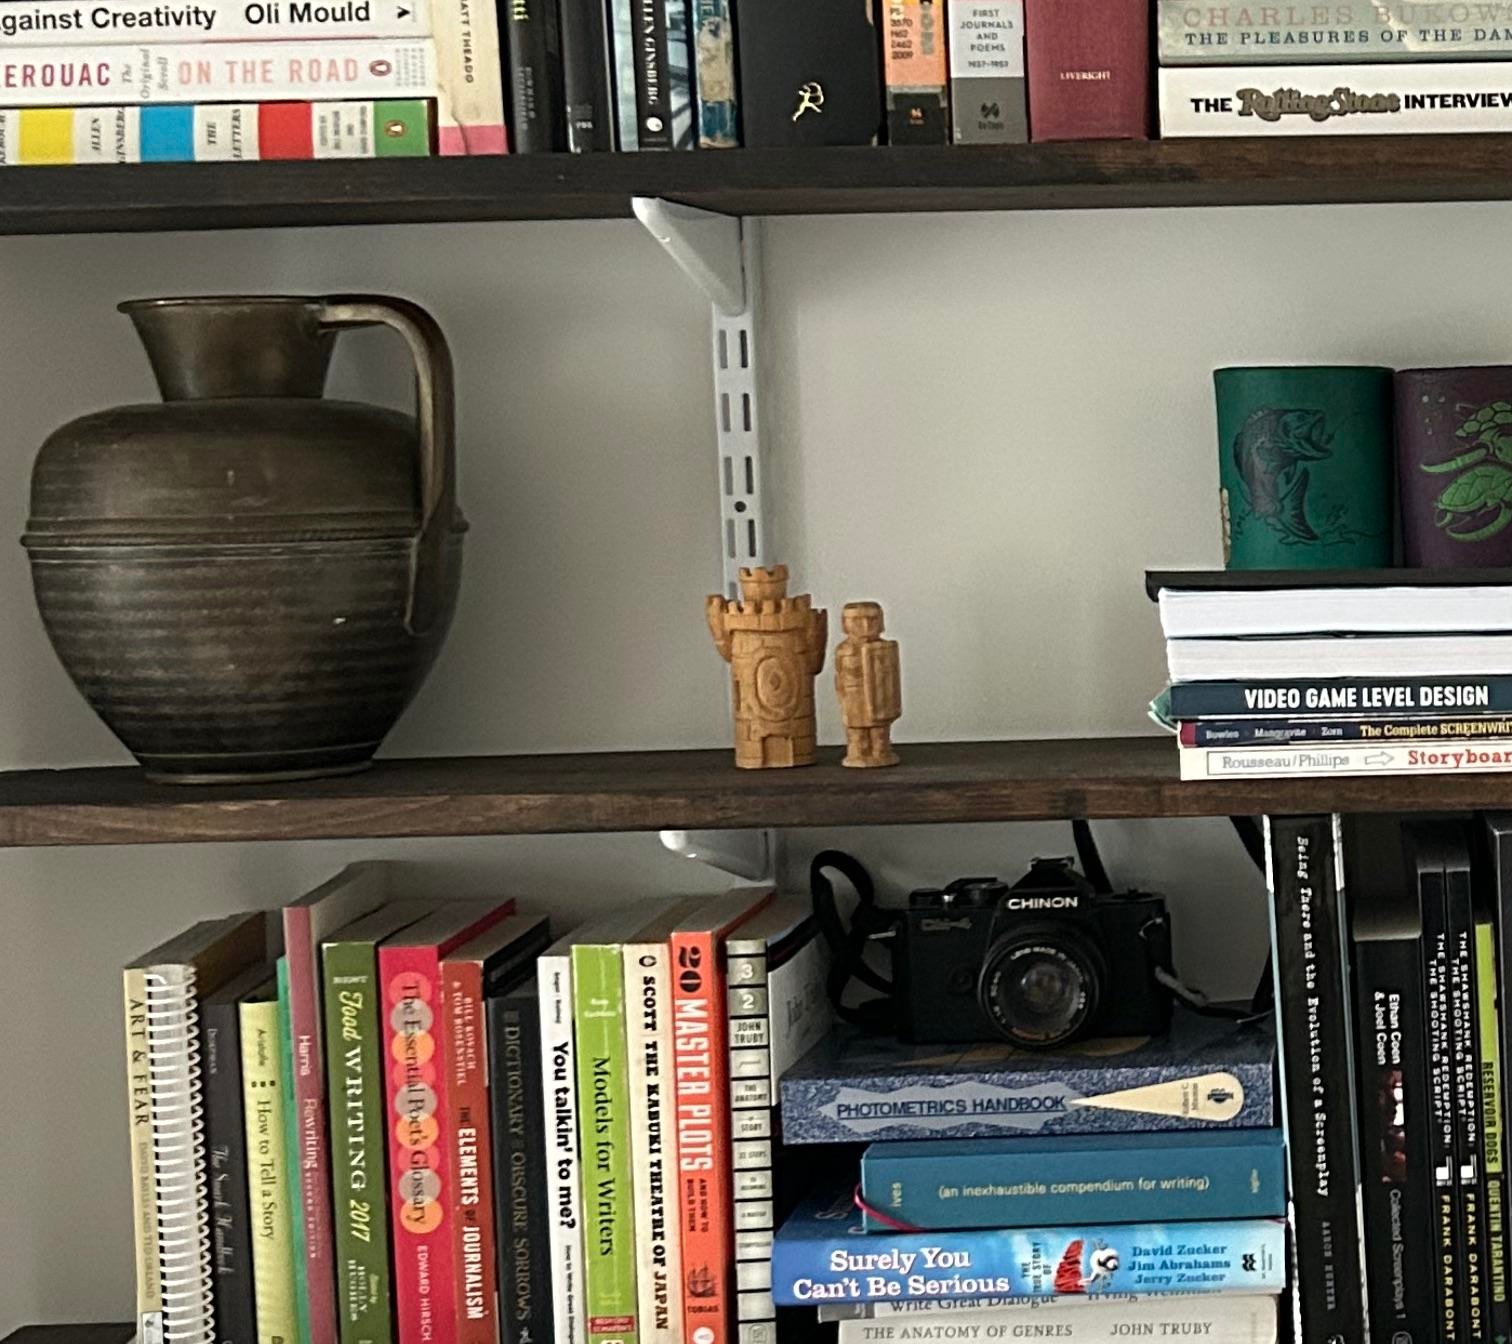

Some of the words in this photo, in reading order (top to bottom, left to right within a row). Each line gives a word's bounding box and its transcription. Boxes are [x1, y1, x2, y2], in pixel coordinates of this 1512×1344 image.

[245, 4, 281, 25] Oli
[289, 1, 370, 24] Mould
[1245, 688, 1300, 710] VIDEO
[1305, 686, 1357, 707] GAME
[1363, 686, 1413, 706] LEVEL
[1420, 685, 1489, 706] DESIGN
[1008, 896, 1077, 910] CHINON
[837, 1098, 966, 1117] PHOTOMETRICS
[973, 1095, 1065, 1113] HANDBOOK
[830, 1249, 912, 1273] Surely
[918, 1248, 970, 1269] You
[794, 1278, 861, 1299] Can't
[867, 1279, 901, 1297] Be
[907, 1275, 1008, 1294] Serious
